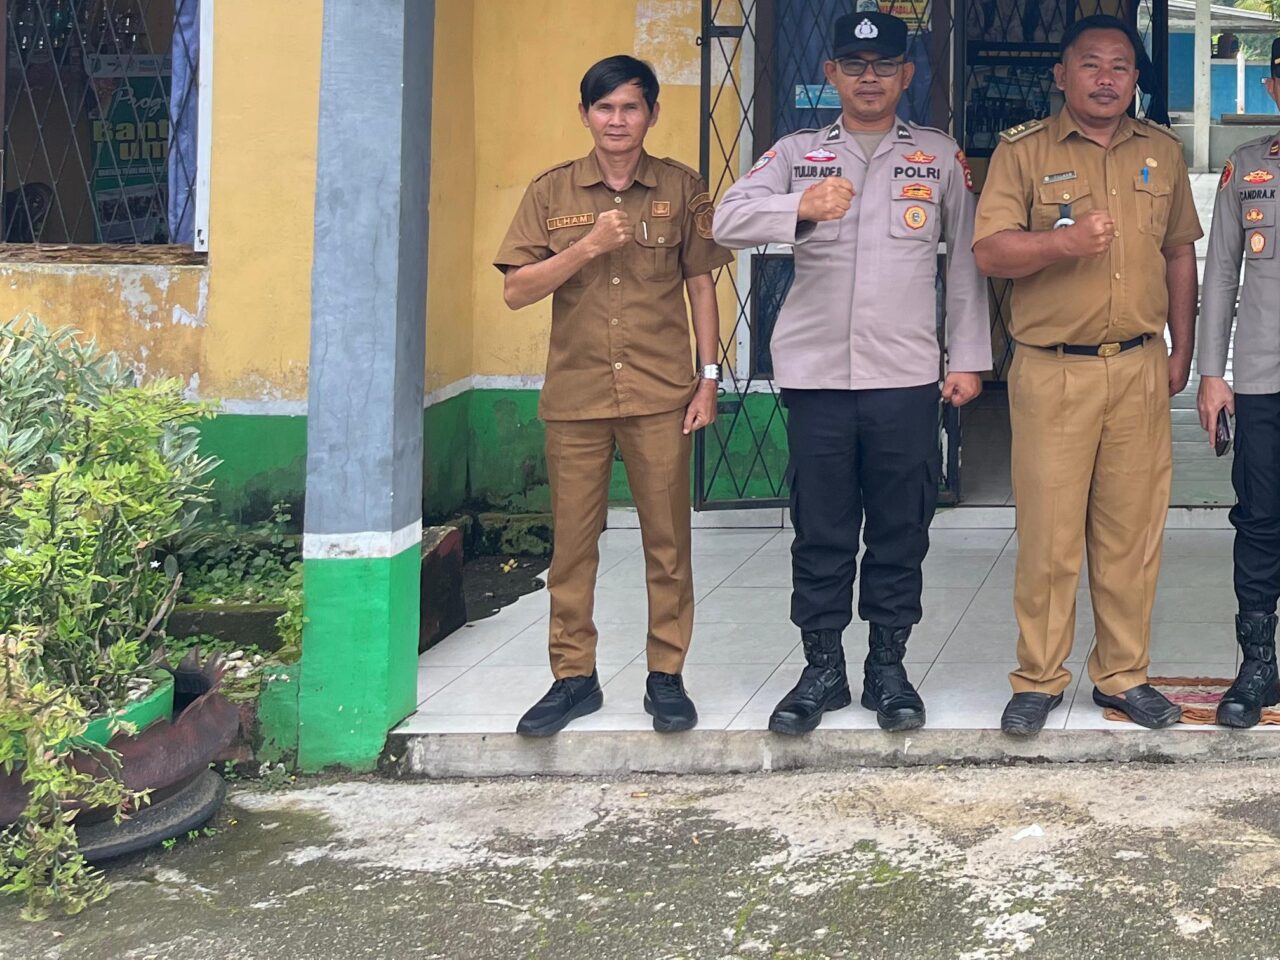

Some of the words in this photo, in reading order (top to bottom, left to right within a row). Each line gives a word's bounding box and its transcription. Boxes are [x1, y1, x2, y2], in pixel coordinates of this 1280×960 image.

[793, 166, 818, 178] TULUS
[894, 166, 941, 180] POLRI
[1239, 189, 1275, 201] CANDRA.K
[554, 215, 589, 227] ILHAM
